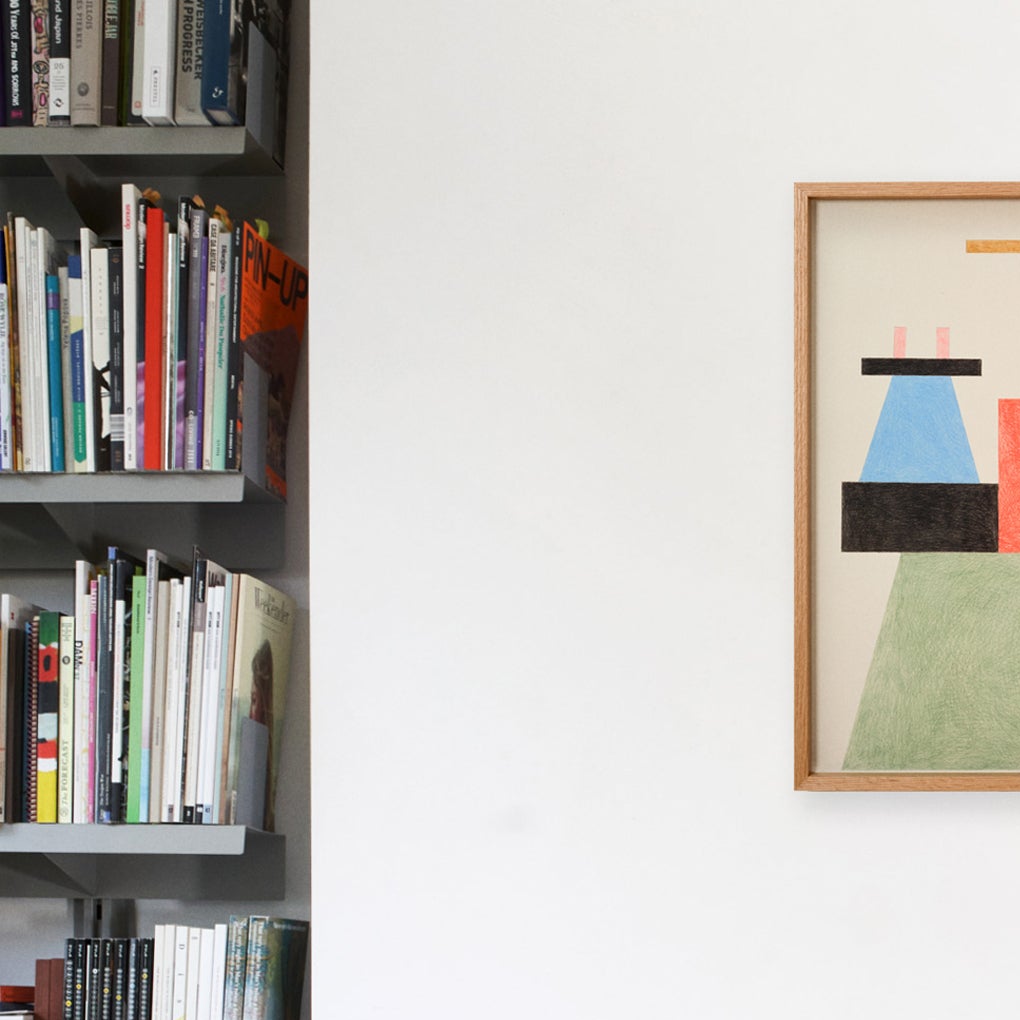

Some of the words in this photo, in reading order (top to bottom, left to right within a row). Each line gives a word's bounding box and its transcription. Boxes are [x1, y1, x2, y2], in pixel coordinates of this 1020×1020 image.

[53, 14, 62, 44] Japan
[75, 13, 83, 49] PIERRES
[182, 6, 194, 73] PROGRESS
